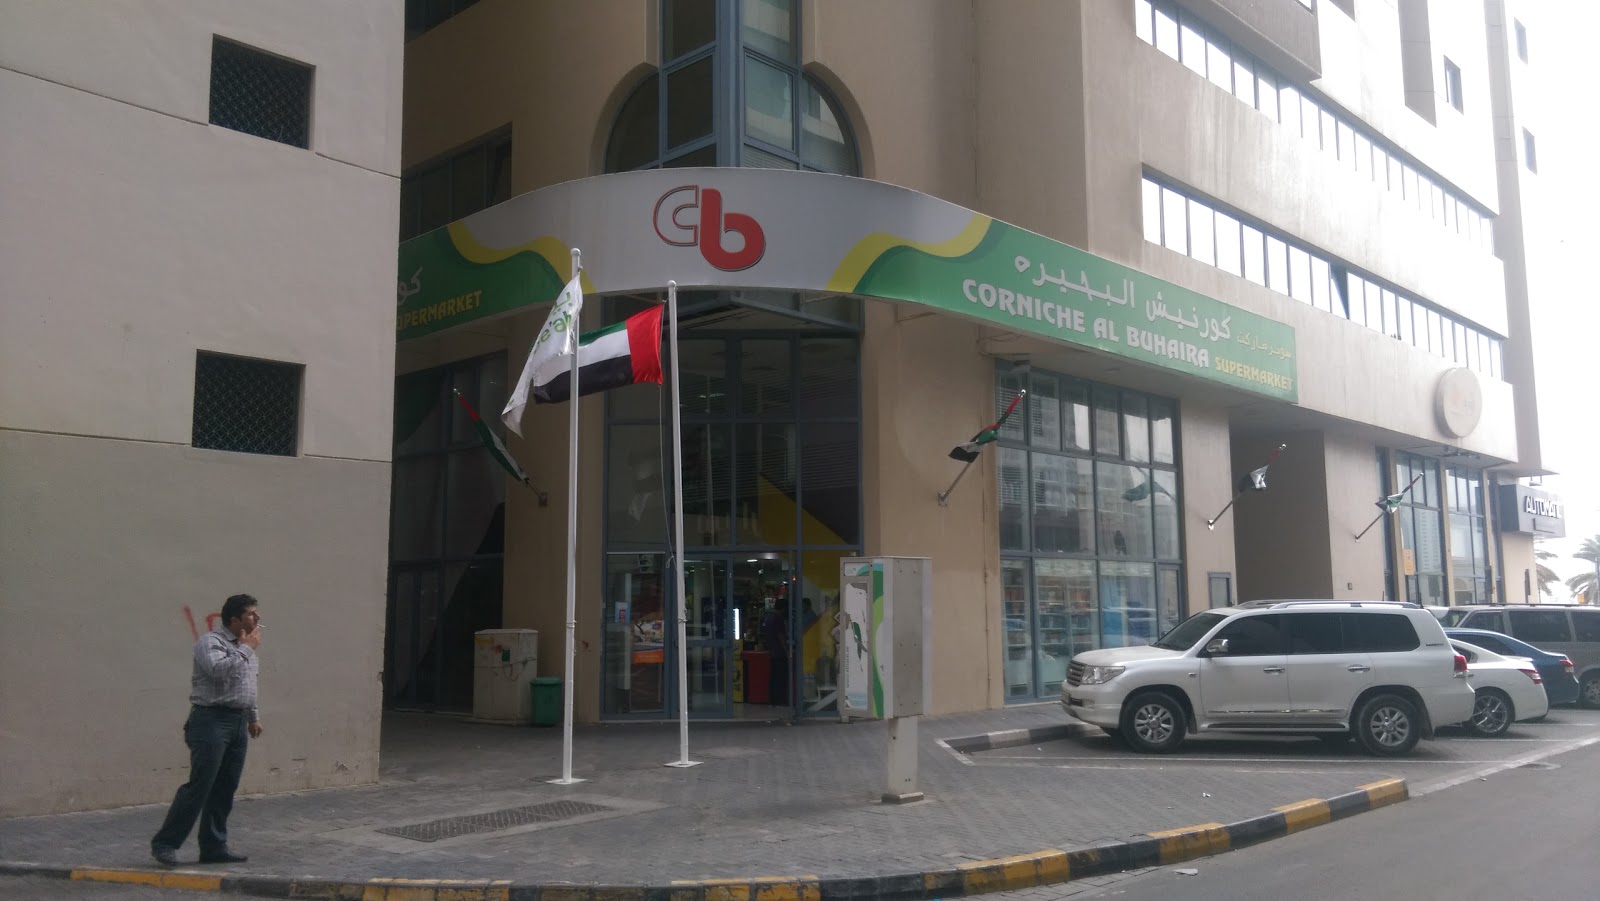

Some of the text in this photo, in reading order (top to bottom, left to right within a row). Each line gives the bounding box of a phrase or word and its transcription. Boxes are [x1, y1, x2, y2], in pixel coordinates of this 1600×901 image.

[397, 289, 483, 331] UPERMARKET
[962, 278, 1294, 391] CORNICHE AL BUHAIRA SUPERMARKET
[1145, 291, 1231, 342] كورنيش
